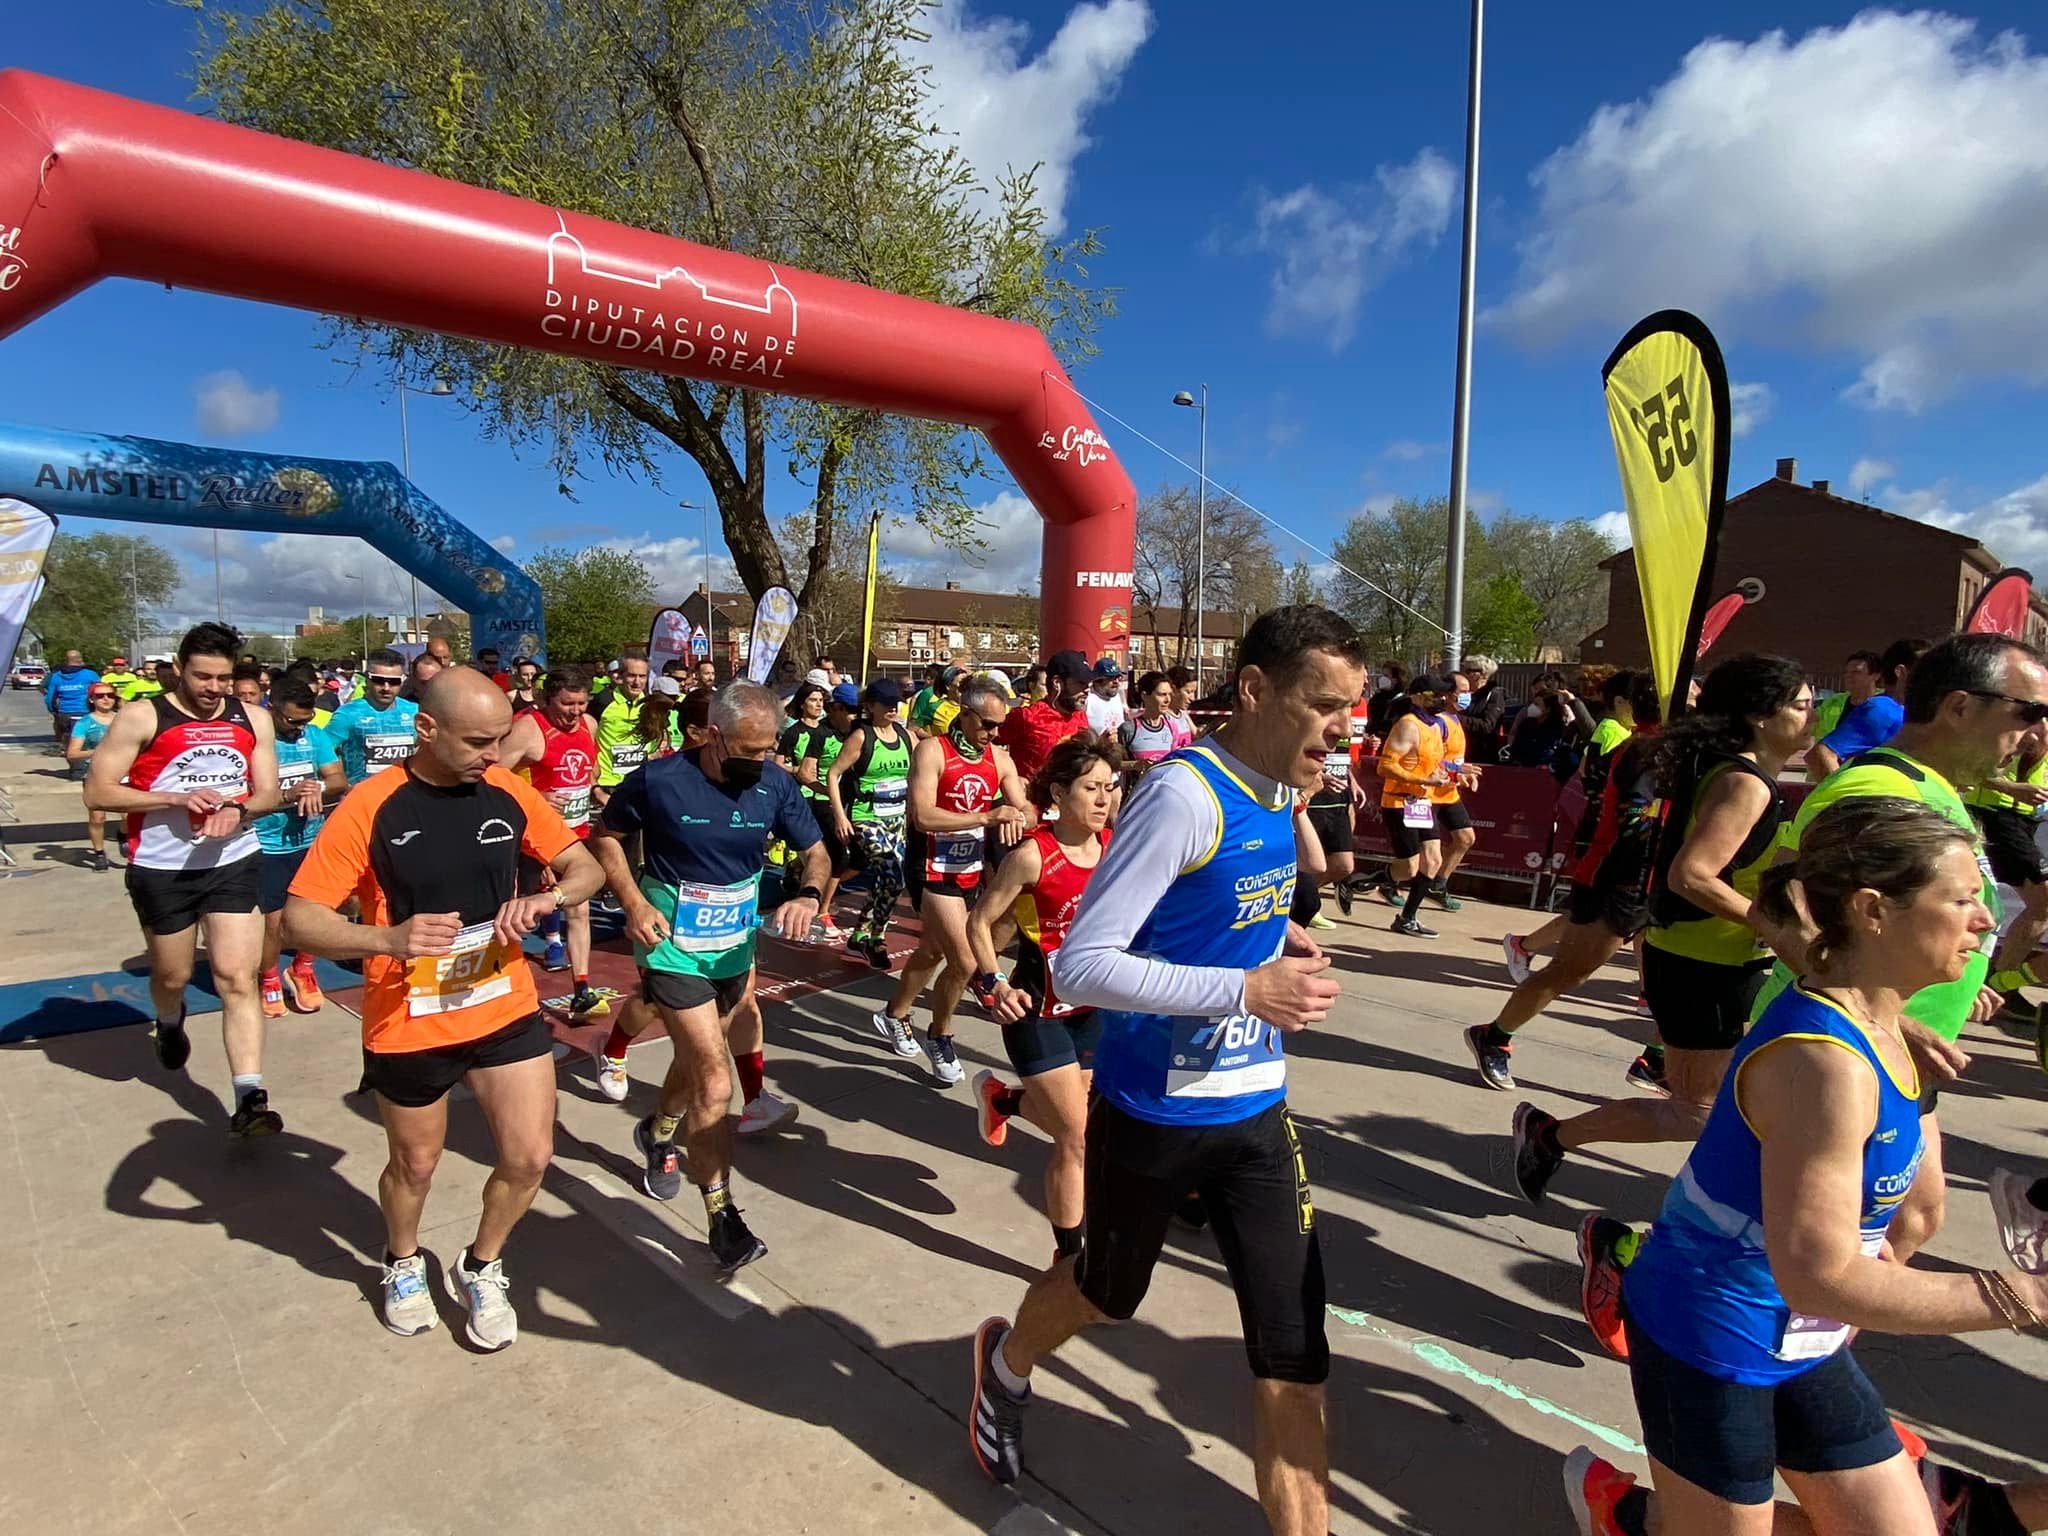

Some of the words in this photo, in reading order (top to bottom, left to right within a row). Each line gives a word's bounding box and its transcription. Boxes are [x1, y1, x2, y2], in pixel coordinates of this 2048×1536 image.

[546, 290, 748, 345] DIPUTACIÓN
[765, 336, 796, 355] DE
[541, 314, 695, 360] CIUDAD
[707, 346, 784, 378] REAL
[1038, 431, 1056, 448] La
[1053, 451, 1070, 461] del
[1077, 444, 1107, 467] Vino
[34, 463, 188, 501] AMSTEL
[199, 474, 305, 510] Radler
[388, 506, 446, 552] AMSTEL
[489, 620, 540, 632] AMSTEL
[176, 748, 244, 770] ALMAGRO
[374, 746, 408, 759] 2470
[949, 842, 976, 857] 457
[696, 906, 740, 927] 824
[435, 950, 487, 981] 557
[1206, 1015, 1262, 1050] 760
[1219, 1054, 1249, 1067] ANTONIO
